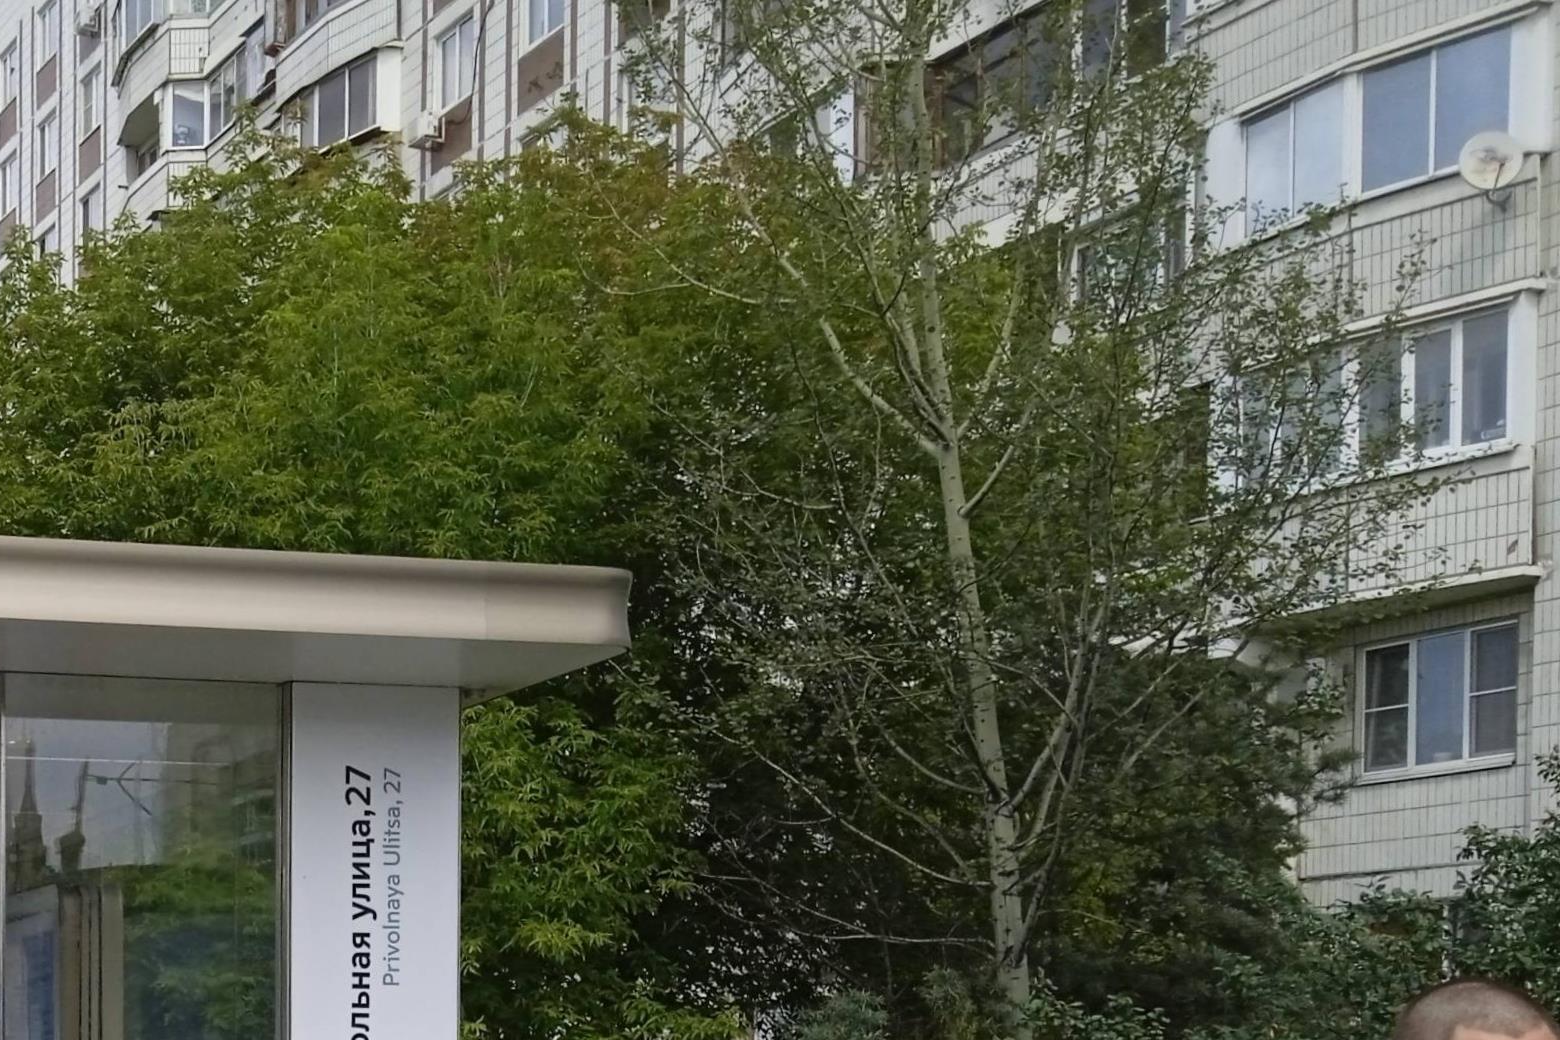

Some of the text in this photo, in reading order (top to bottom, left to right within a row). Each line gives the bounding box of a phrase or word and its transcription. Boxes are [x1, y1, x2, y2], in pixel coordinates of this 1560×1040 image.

[382, 767, 405, 987] Privolnaya Ulitsa, 27
